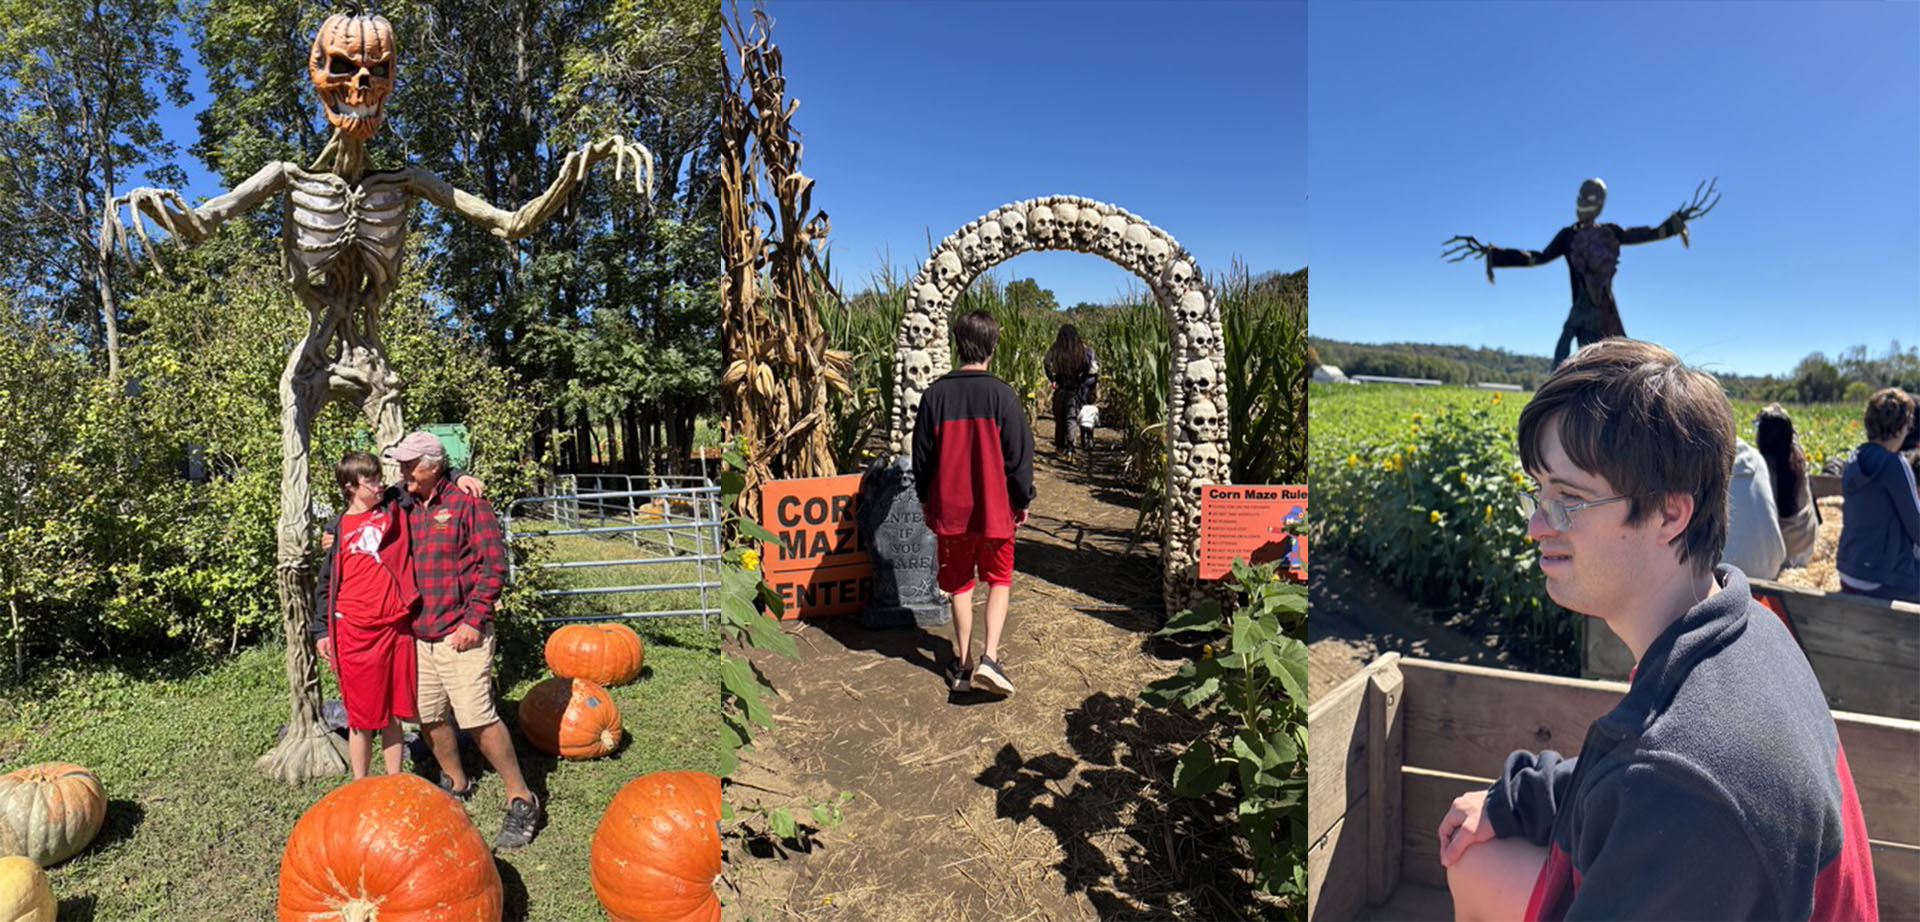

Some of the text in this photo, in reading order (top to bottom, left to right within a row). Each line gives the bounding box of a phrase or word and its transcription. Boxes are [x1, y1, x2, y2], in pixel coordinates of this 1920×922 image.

[1209, 489, 1241, 500] Corn
[1244, 489, 1278, 500] Maze
[884, 511, 923, 523] NTE
[900, 527, 914, 539] IF
[890, 543, 921, 554] YOU
[893, 556, 931, 570] ARE
[775, 576, 874, 609] ENTER
